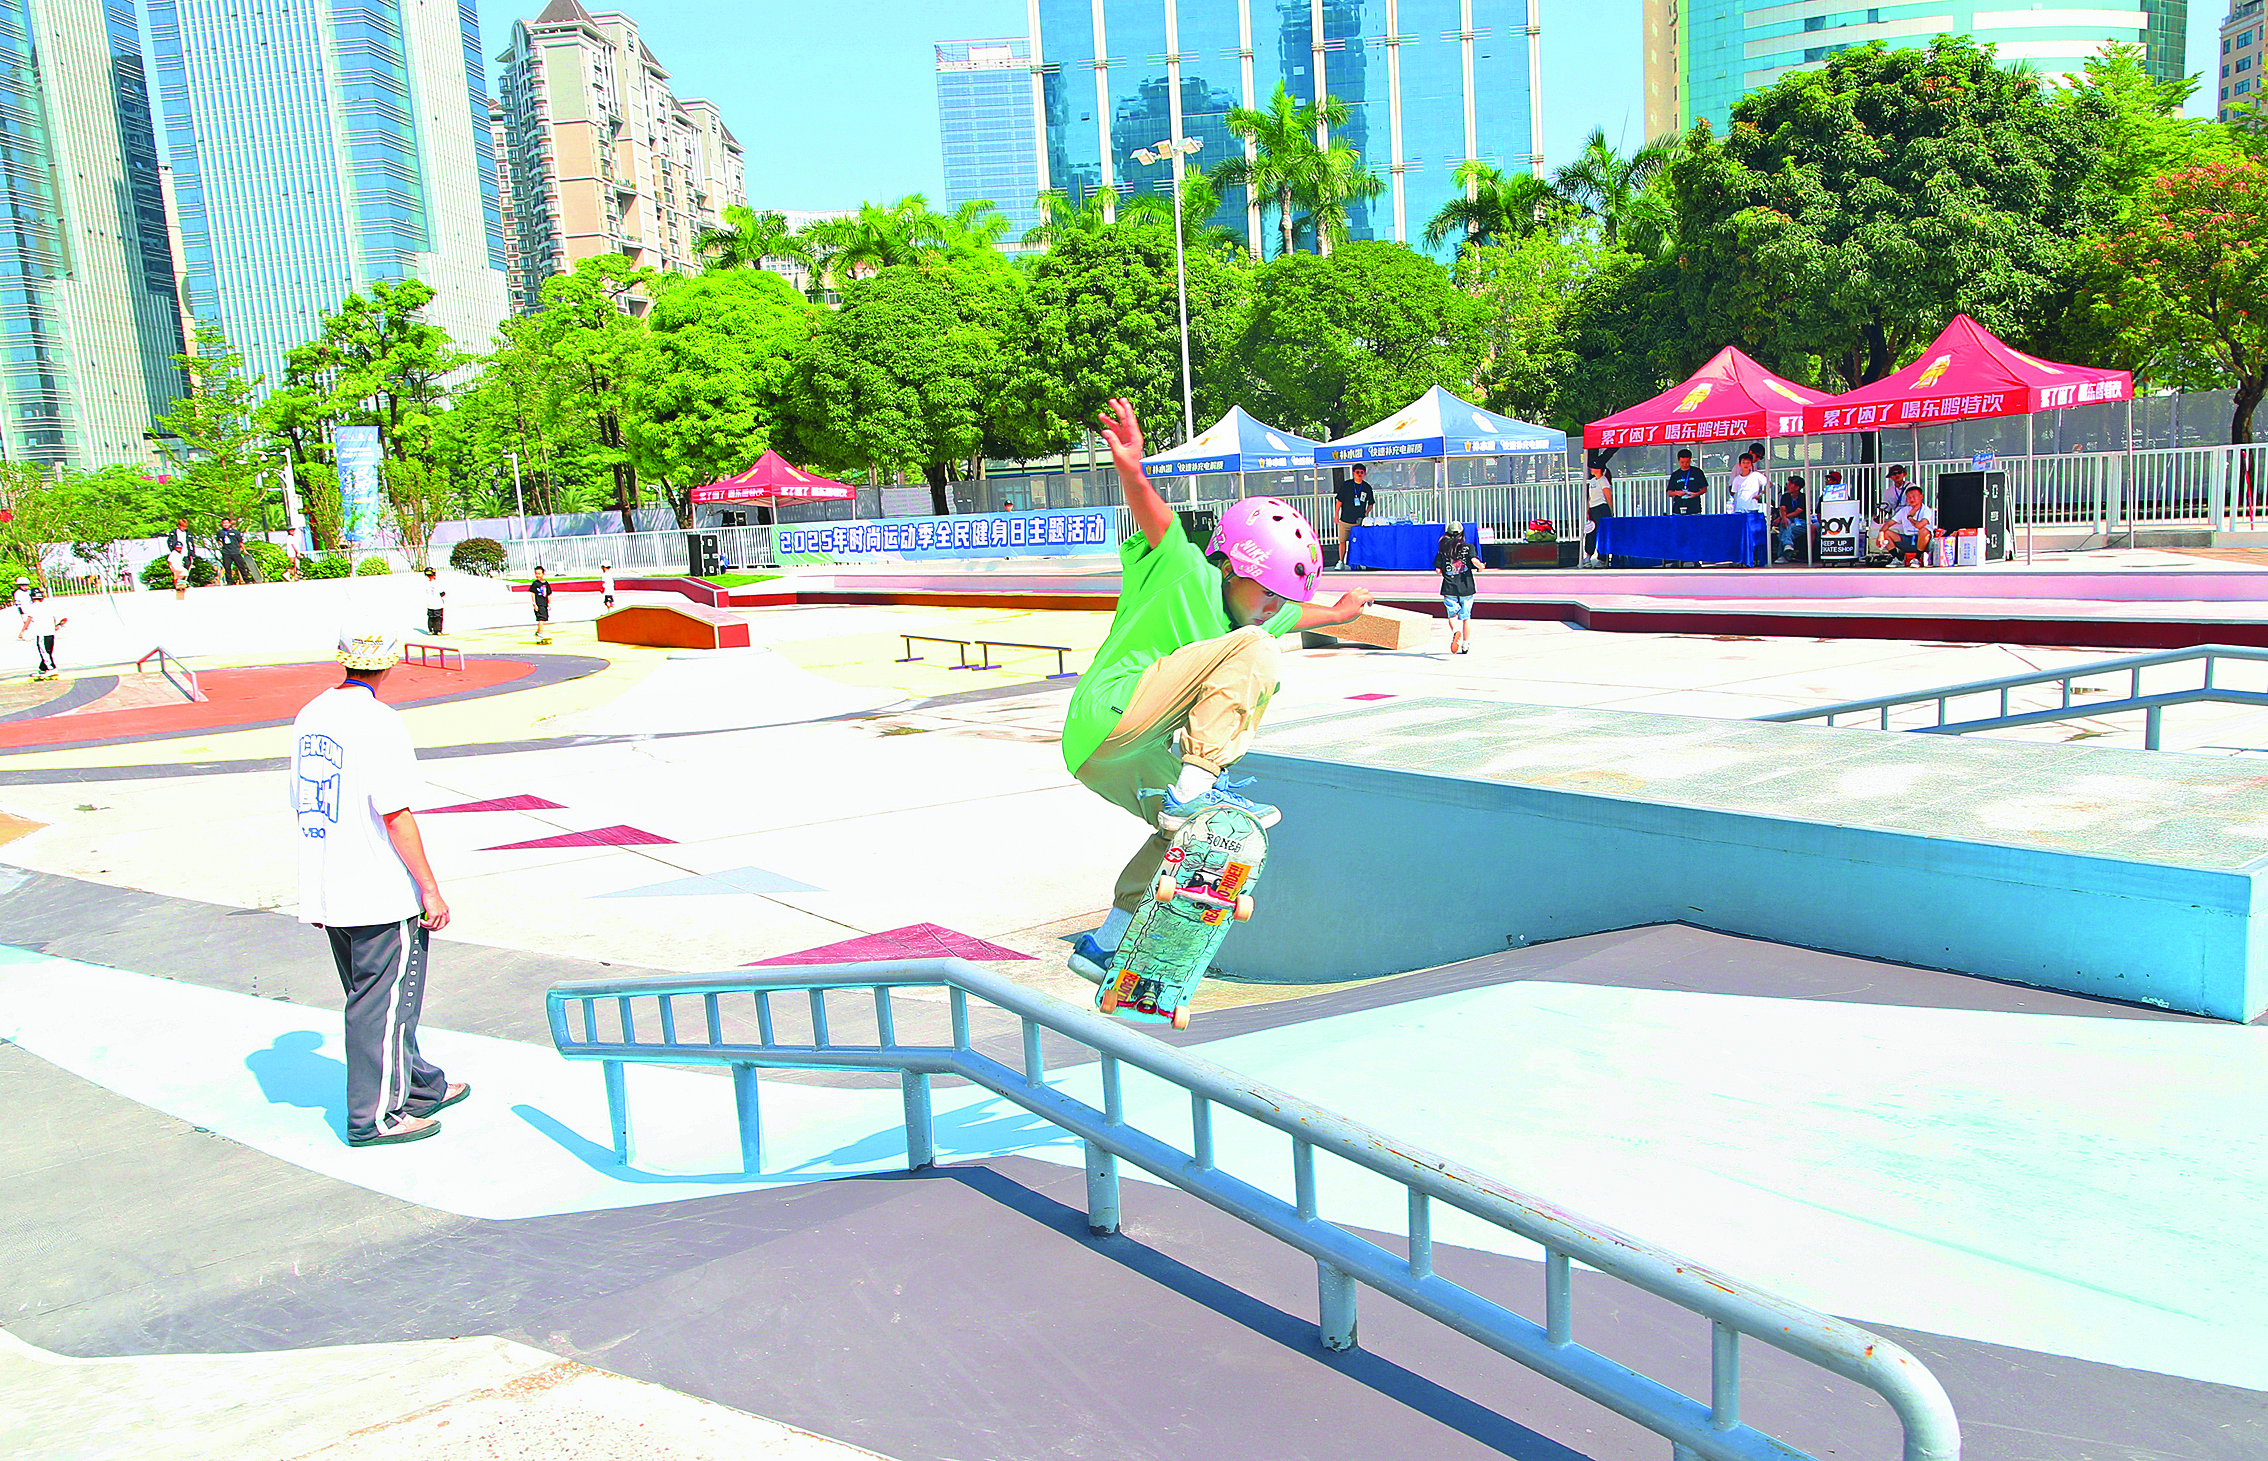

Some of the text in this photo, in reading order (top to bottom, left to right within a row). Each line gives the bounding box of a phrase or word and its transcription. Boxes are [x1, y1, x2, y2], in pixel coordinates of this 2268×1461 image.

[1822, 394, 2005, 427] 累了困了 喝东鹏特饮
[1600, 419, 1748, 445] 累了困了 喝东鹏特饮
[779, 514, 1105, 554] 2025年时尚运动季全民健身日主题活动
[1240, 539, 1270, 562] NIKE
[1244, 563, 1264, 578] SB
[1206, 832, 1242, 854] BONES
[1202, 908, 1223, 924] REA
